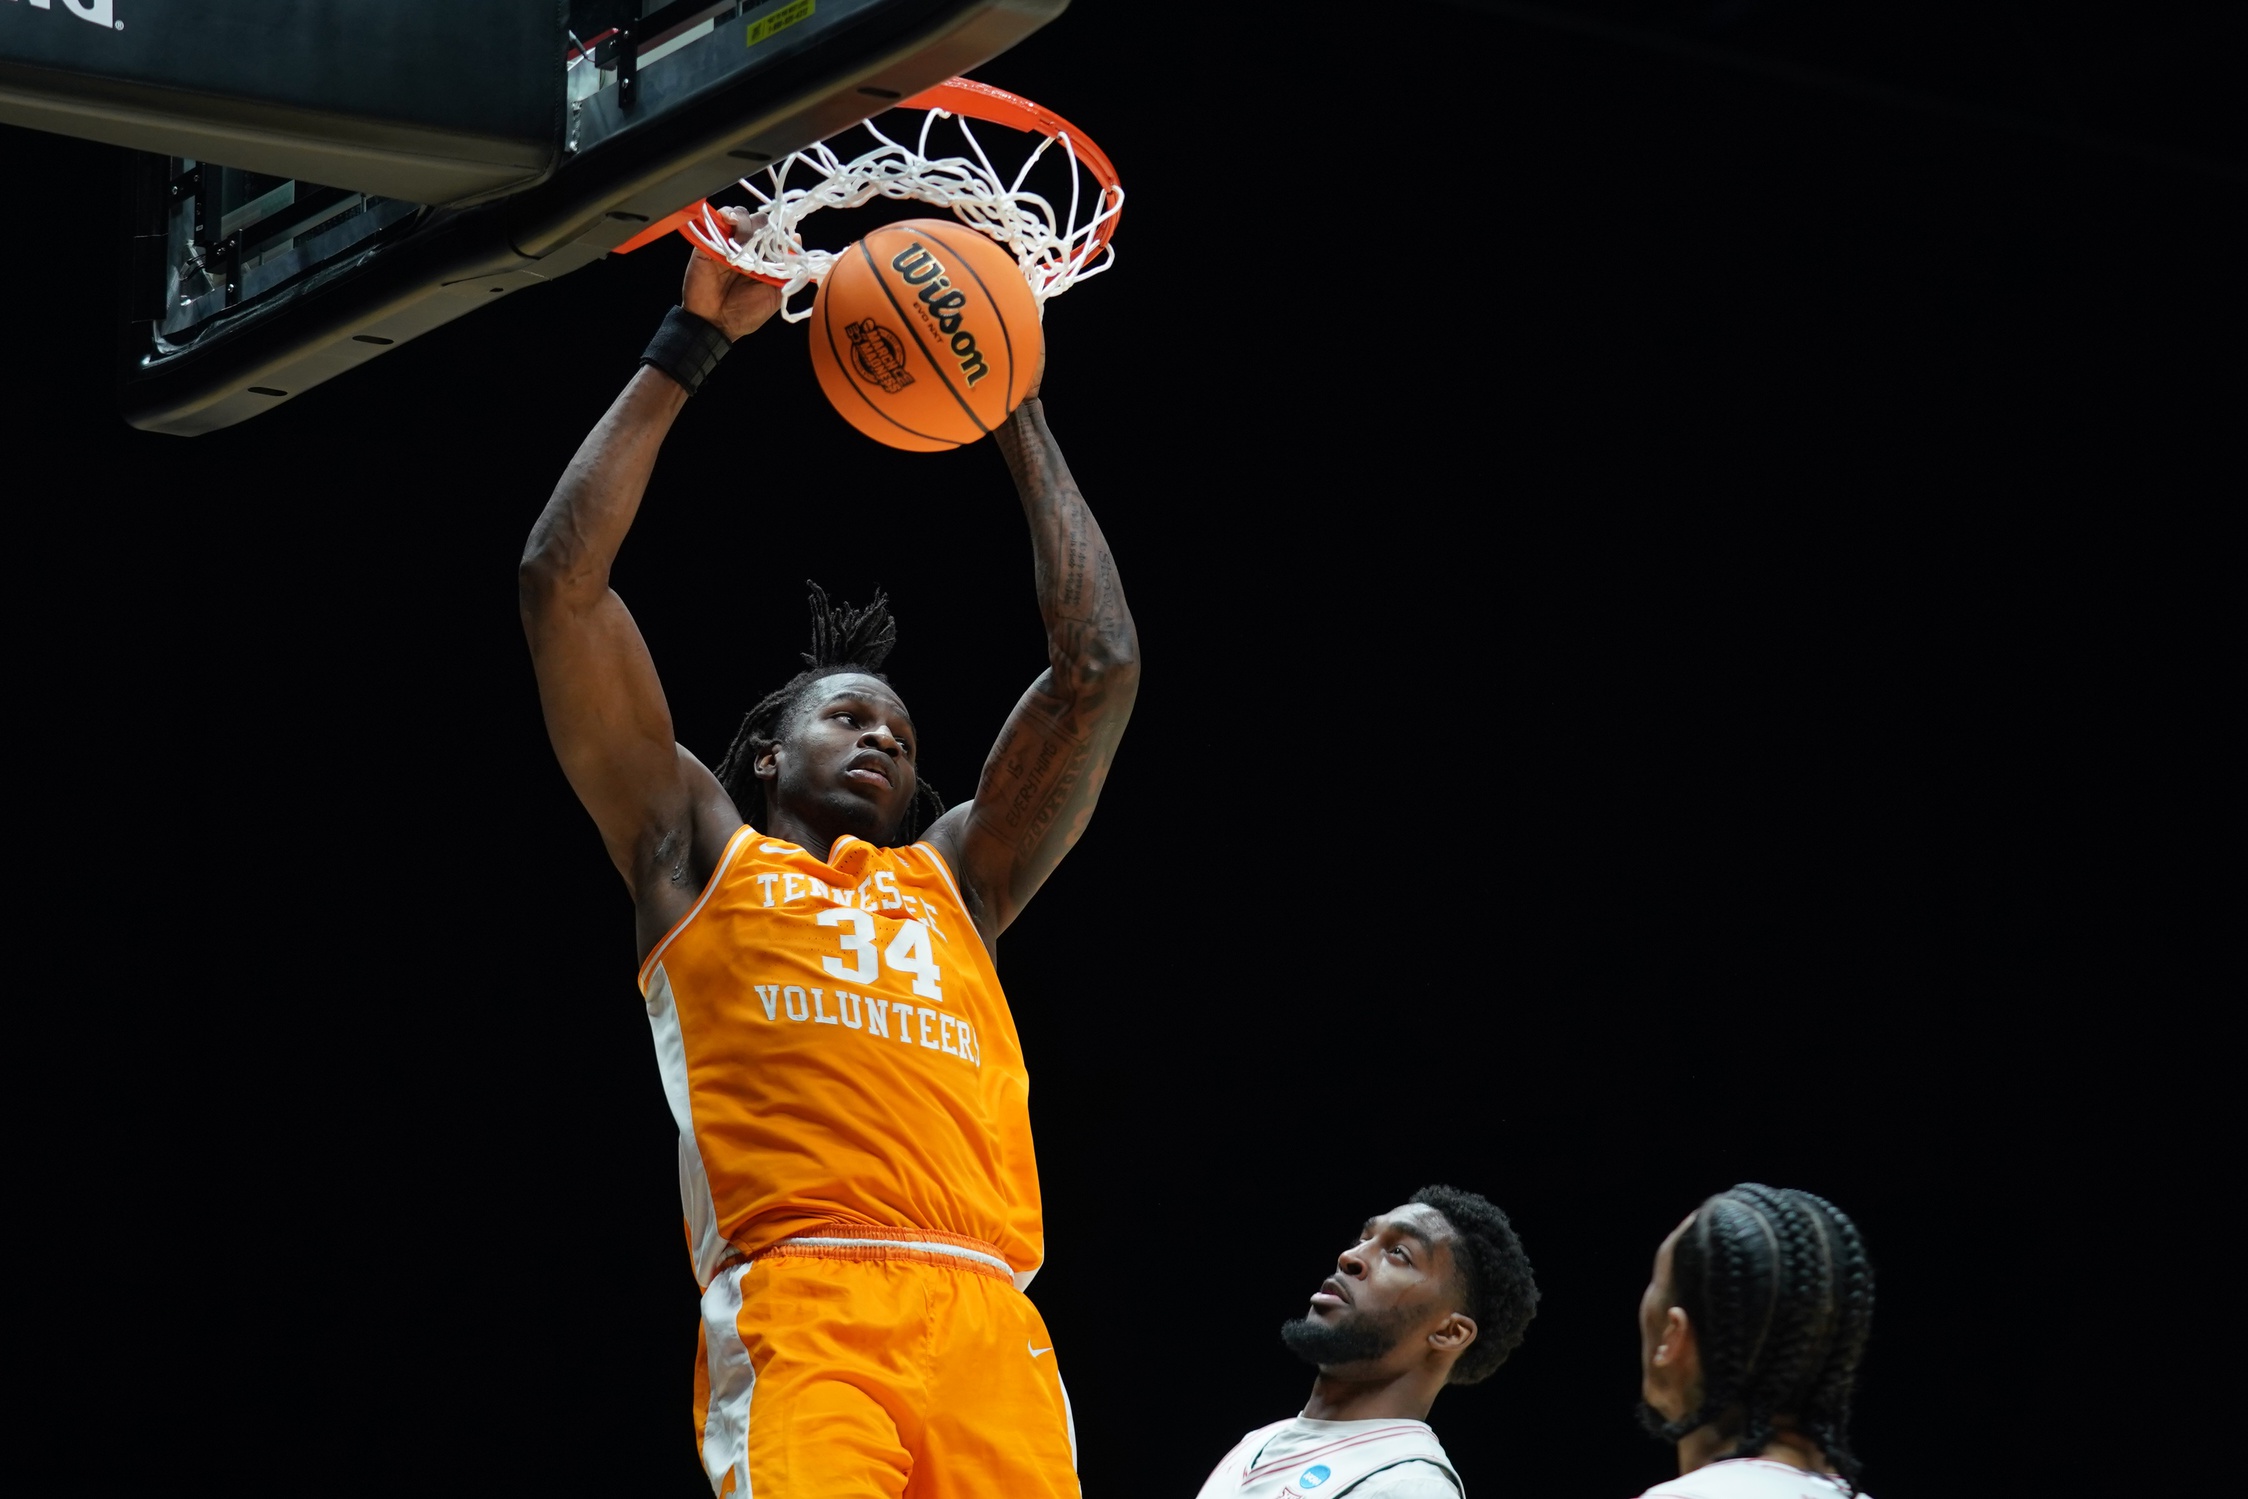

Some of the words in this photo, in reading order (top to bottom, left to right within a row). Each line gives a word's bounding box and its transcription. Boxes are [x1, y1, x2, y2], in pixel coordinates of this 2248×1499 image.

[866, 330, 899, 371] MARCH
[892, 242, 989, 388] Wilson
[913, 302, 929, 322] EVO
[928, 323, 944, 343] NXT
[860, 341, 902, 393] MADNESS
[1005, 741, 1058, 829] EVERYTHING
[757, 871, 949, 943] TENNESEE
[816, 908, 943, 1002] 34
